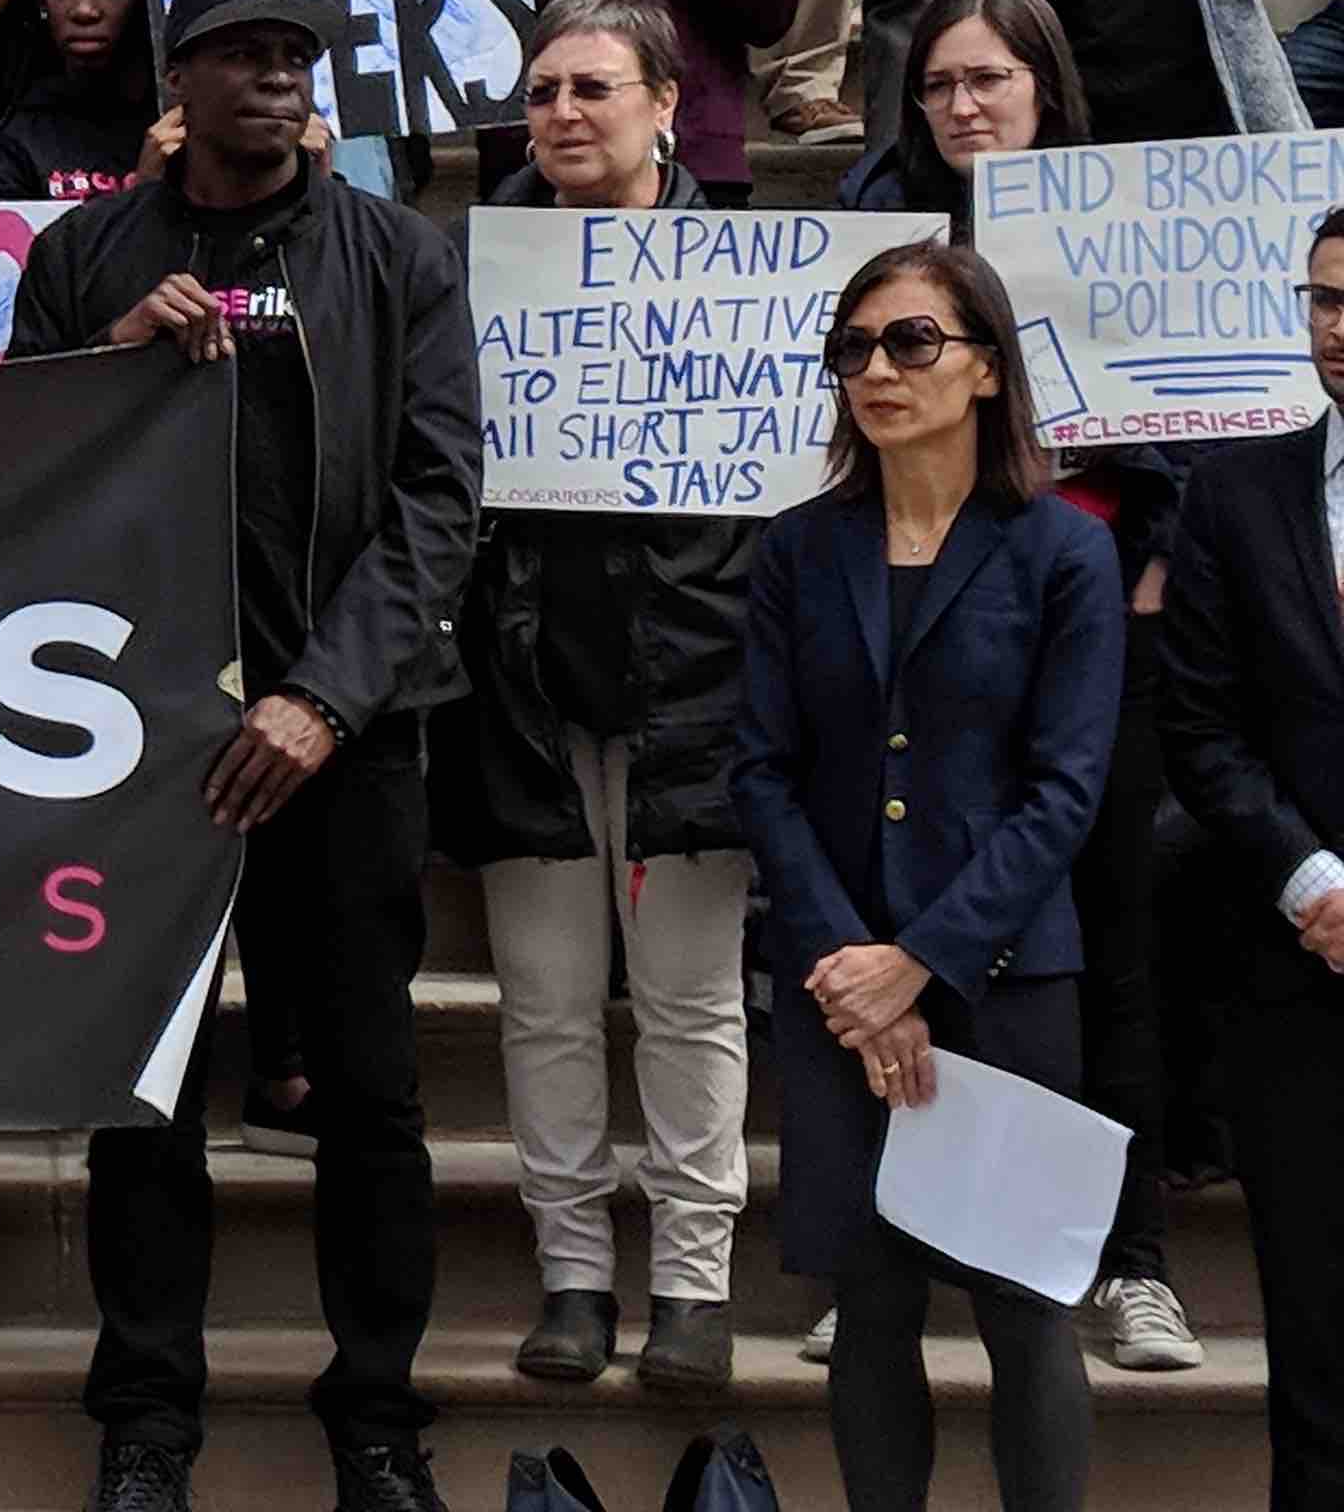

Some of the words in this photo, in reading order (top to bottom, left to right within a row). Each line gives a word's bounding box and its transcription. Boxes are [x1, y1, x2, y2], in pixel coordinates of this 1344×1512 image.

[987, 151, 1114, 220] END
[580, 215, 830, 288] EXPAND
[1088, 278, 1310, 341] POLICIN
[501, 368, 557, 405] TO
[559, 408, 704, 460] SHORT
[1052, 406, 1313, 444] #CLOSERIKERS
[622, 458, 766, 507] STAYS
